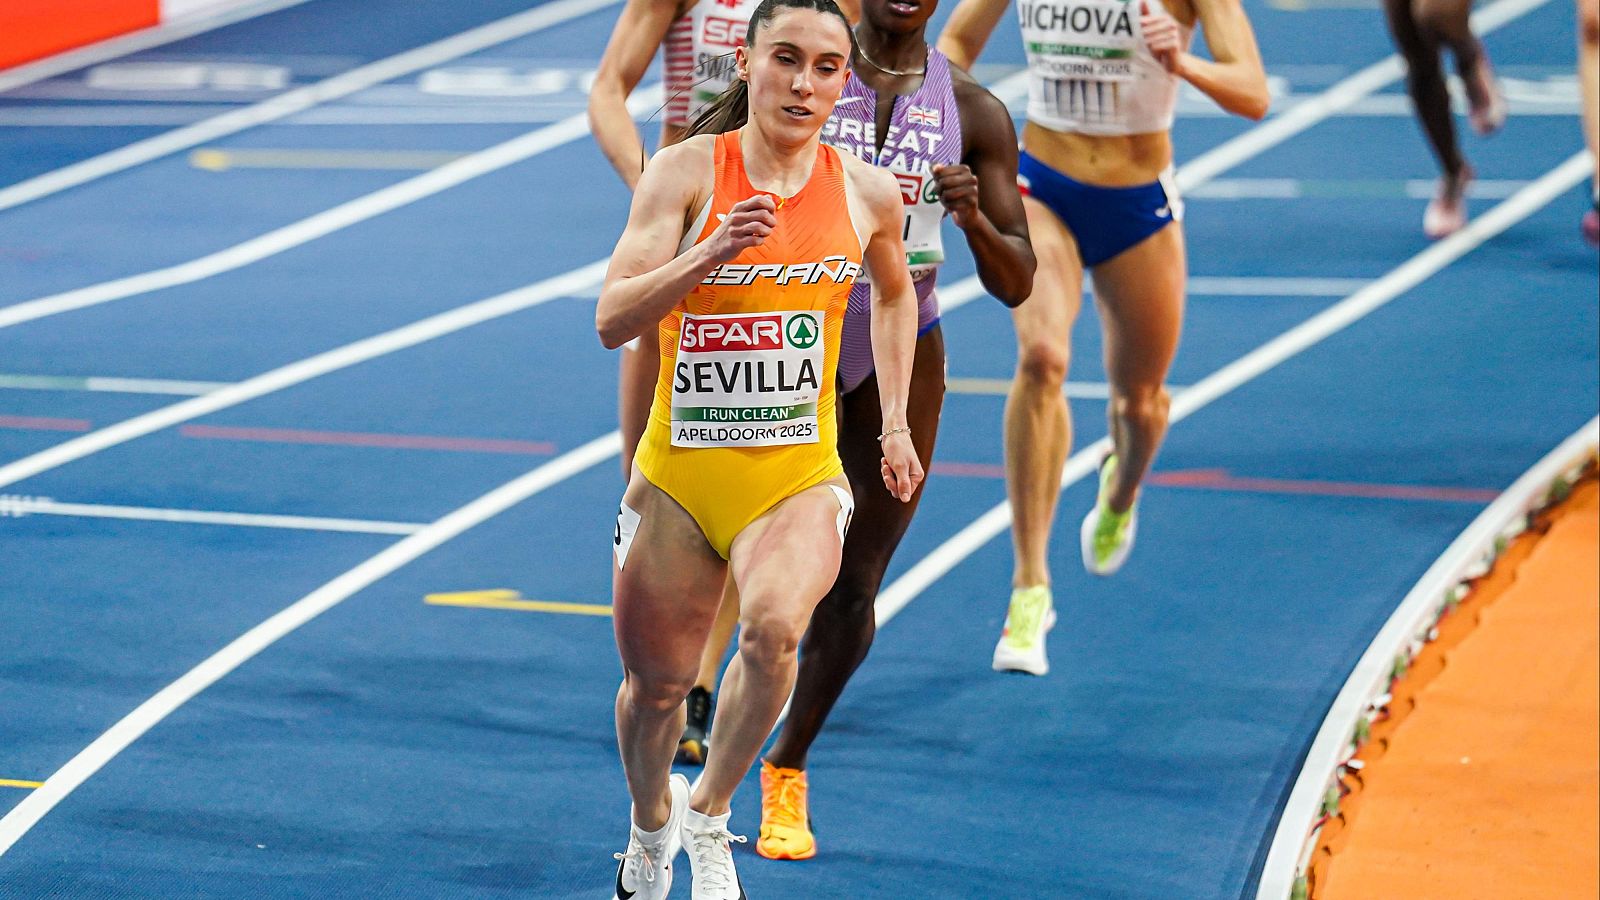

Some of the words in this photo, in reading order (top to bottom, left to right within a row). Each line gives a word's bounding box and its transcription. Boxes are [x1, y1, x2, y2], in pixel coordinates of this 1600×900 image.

[705, 19, 749, 44] SP
[821, 115, 944, 155] GREAT
[822, 140, 933, 180] ITAIN
[682, 319, 780, 348] SPAR
[674, 358, 818, 394] SEVILLA
[703, 408, 707, 421] I
[709, 408, 740, 421] RUN
[677, 427, 776, 442] APELDOORN
[780, 422, 812, 438] 2025
